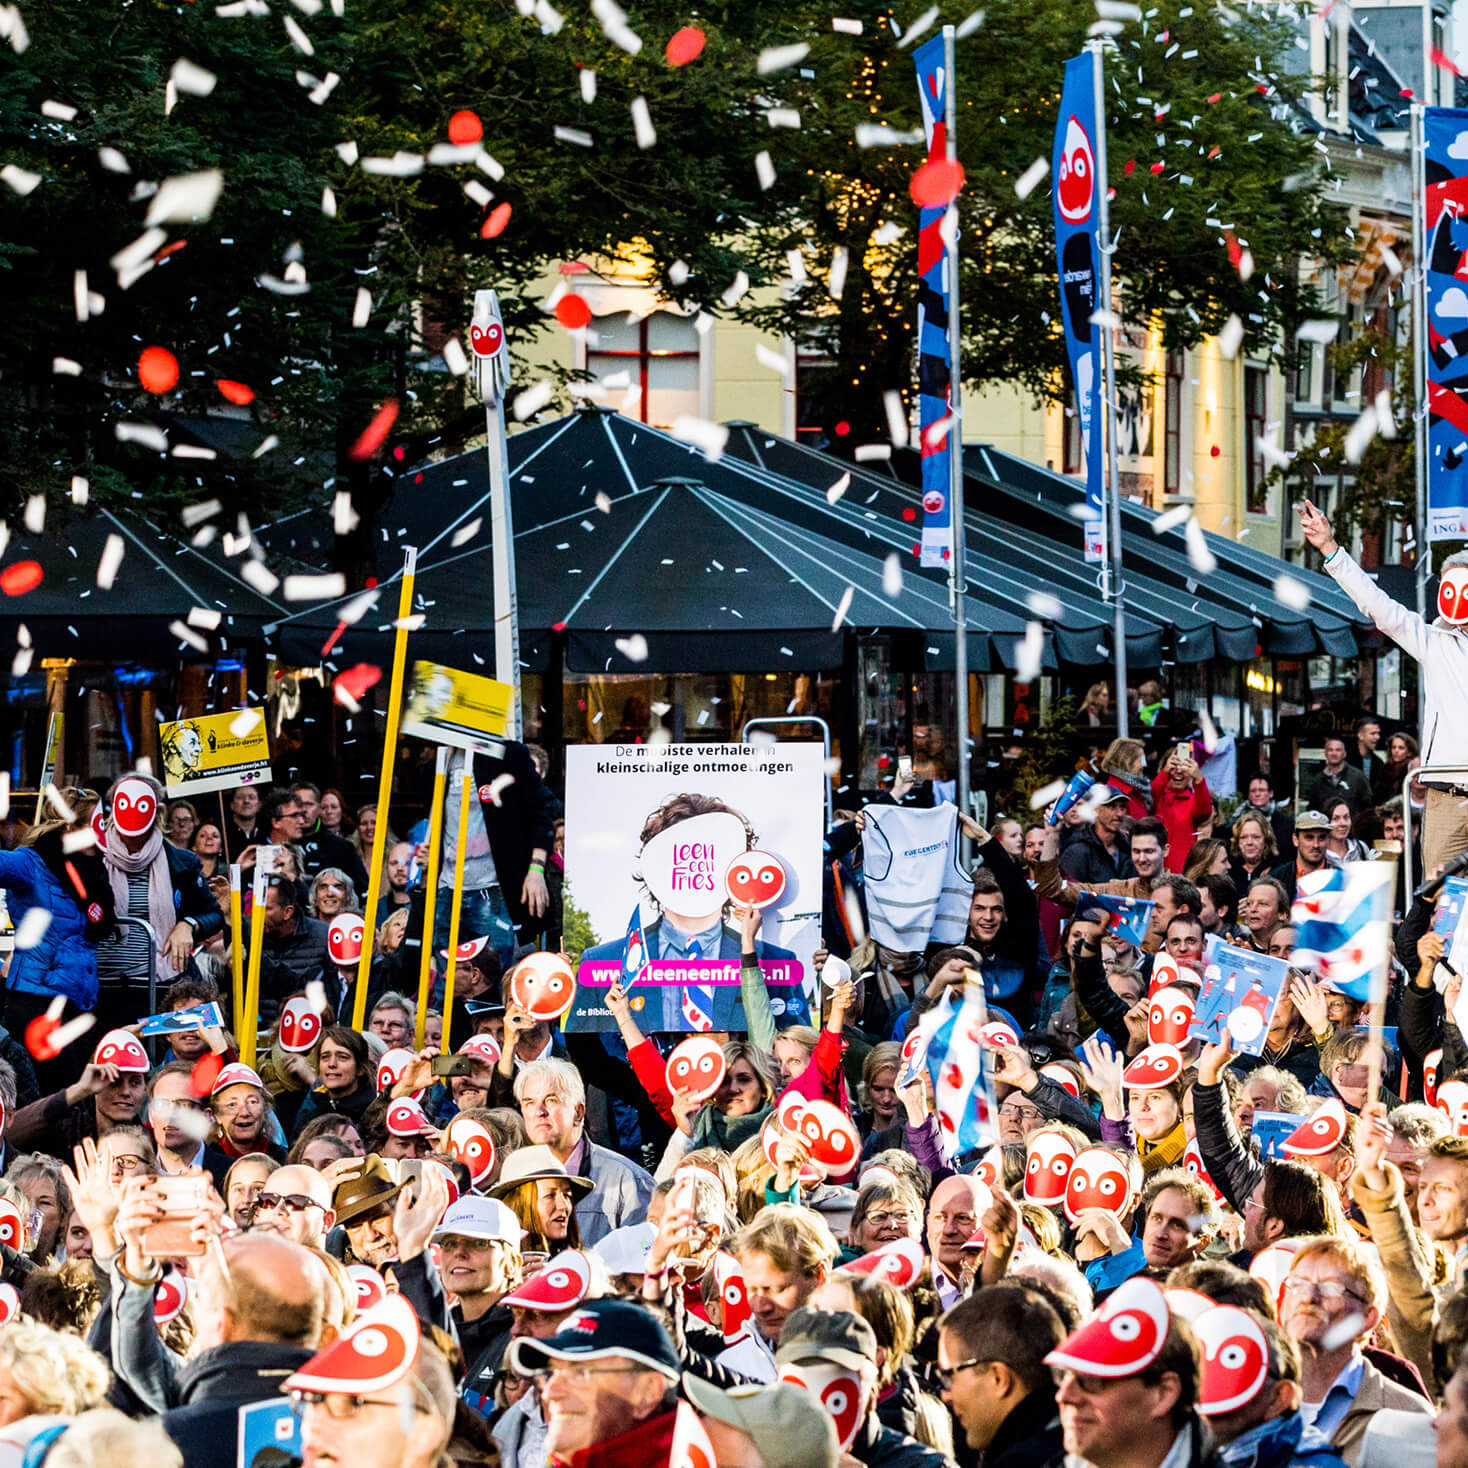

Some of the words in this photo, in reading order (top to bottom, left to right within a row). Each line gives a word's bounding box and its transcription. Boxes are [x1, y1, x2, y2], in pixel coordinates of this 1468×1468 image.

[1433, 523, 1457, 534] ING
[615, 745, 633, 757] De
[597, 761, 689, 776] kleinschalige
[693, 761, 793, 776] ontmoengen
[673, 842, 715, 866] Leen
[671, 866, 715, 891] Fries
[576, 1007, 586, 1017] de
